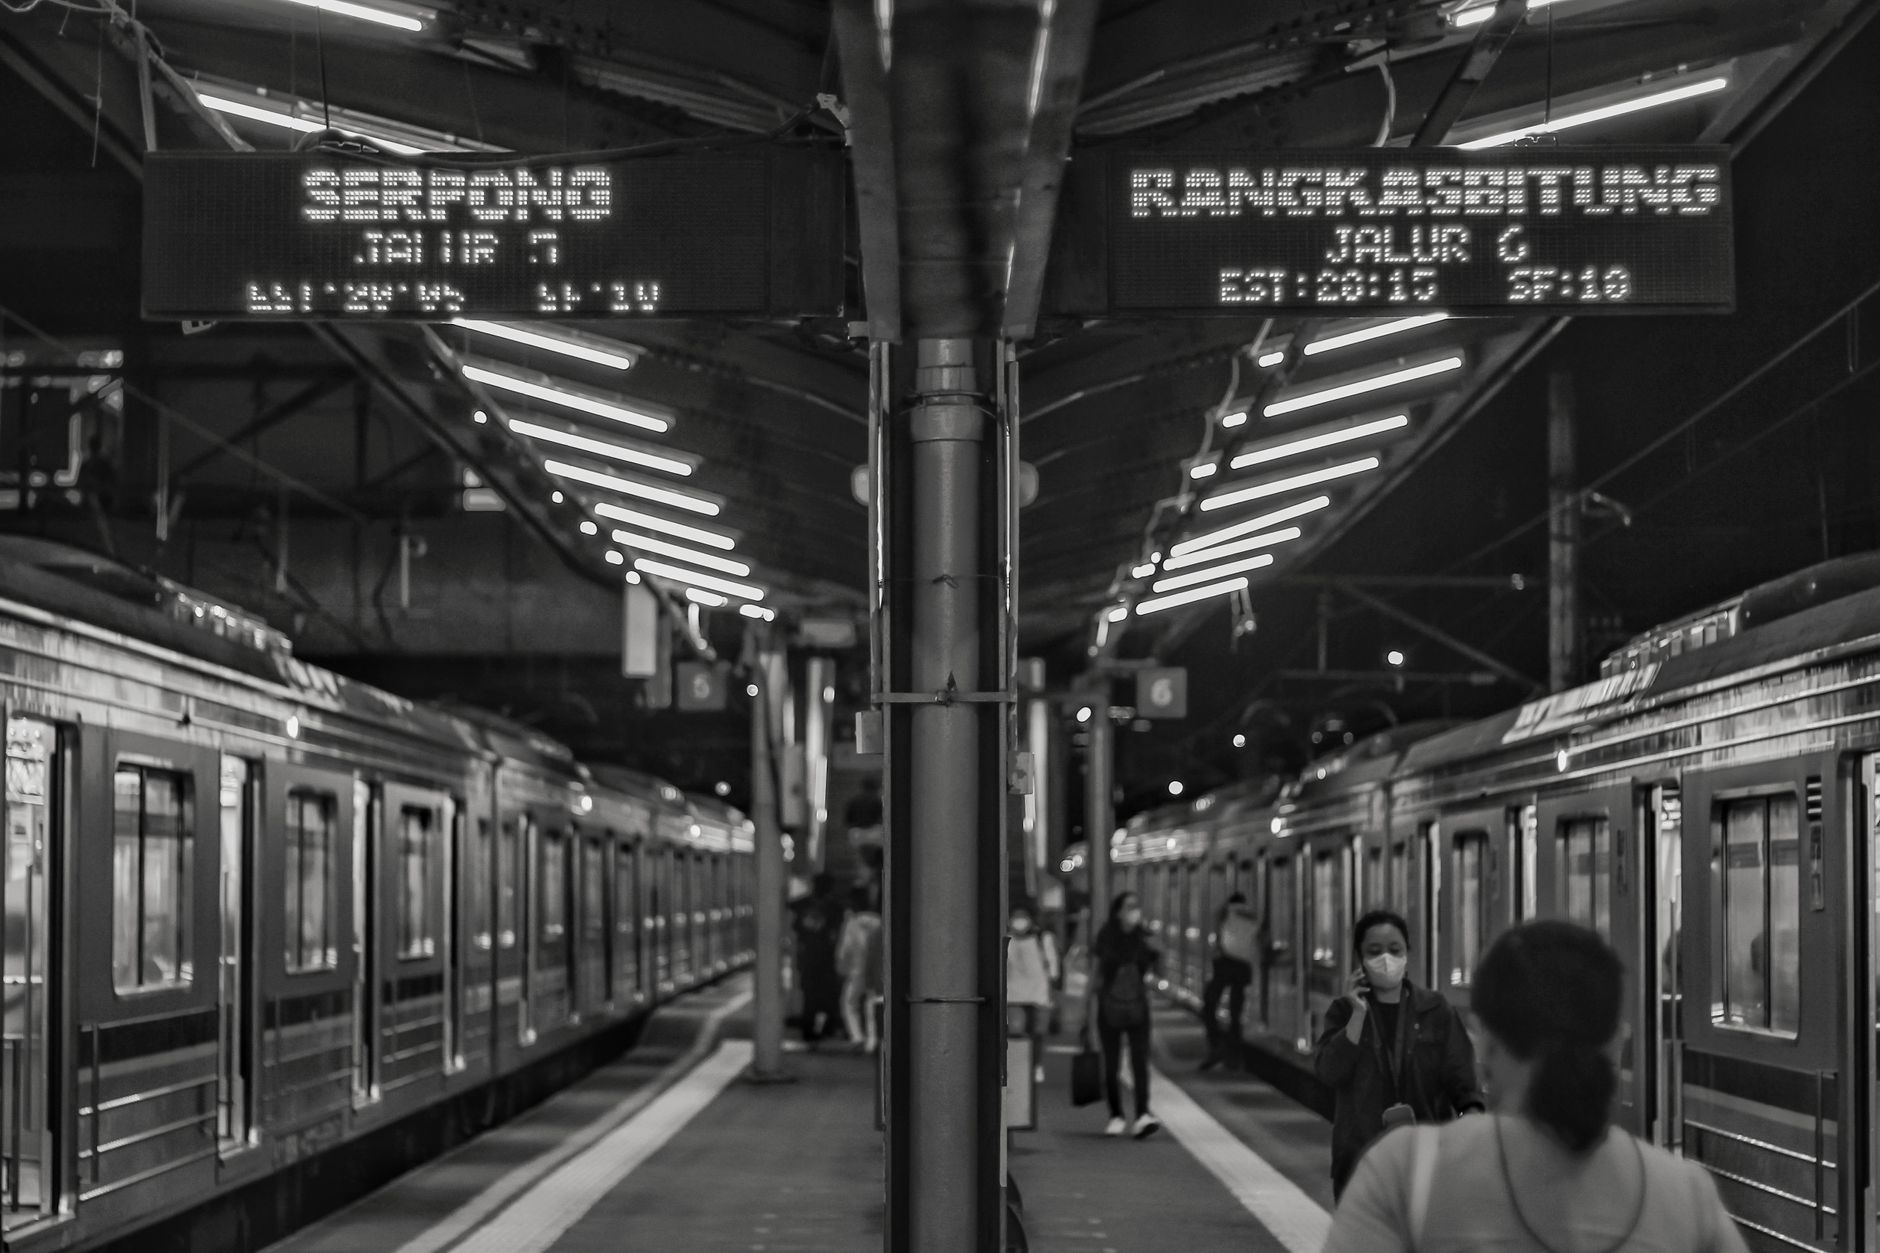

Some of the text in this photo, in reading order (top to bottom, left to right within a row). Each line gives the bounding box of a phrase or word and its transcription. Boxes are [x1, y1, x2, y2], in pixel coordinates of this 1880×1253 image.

[302, 167, 612, 222] SERPONG
[1131, 167, 1720, 218] RANGKASBITUNG
[1324, 225, 1470, 263] JALUR
[1151, 679, 1173, 706] 6
